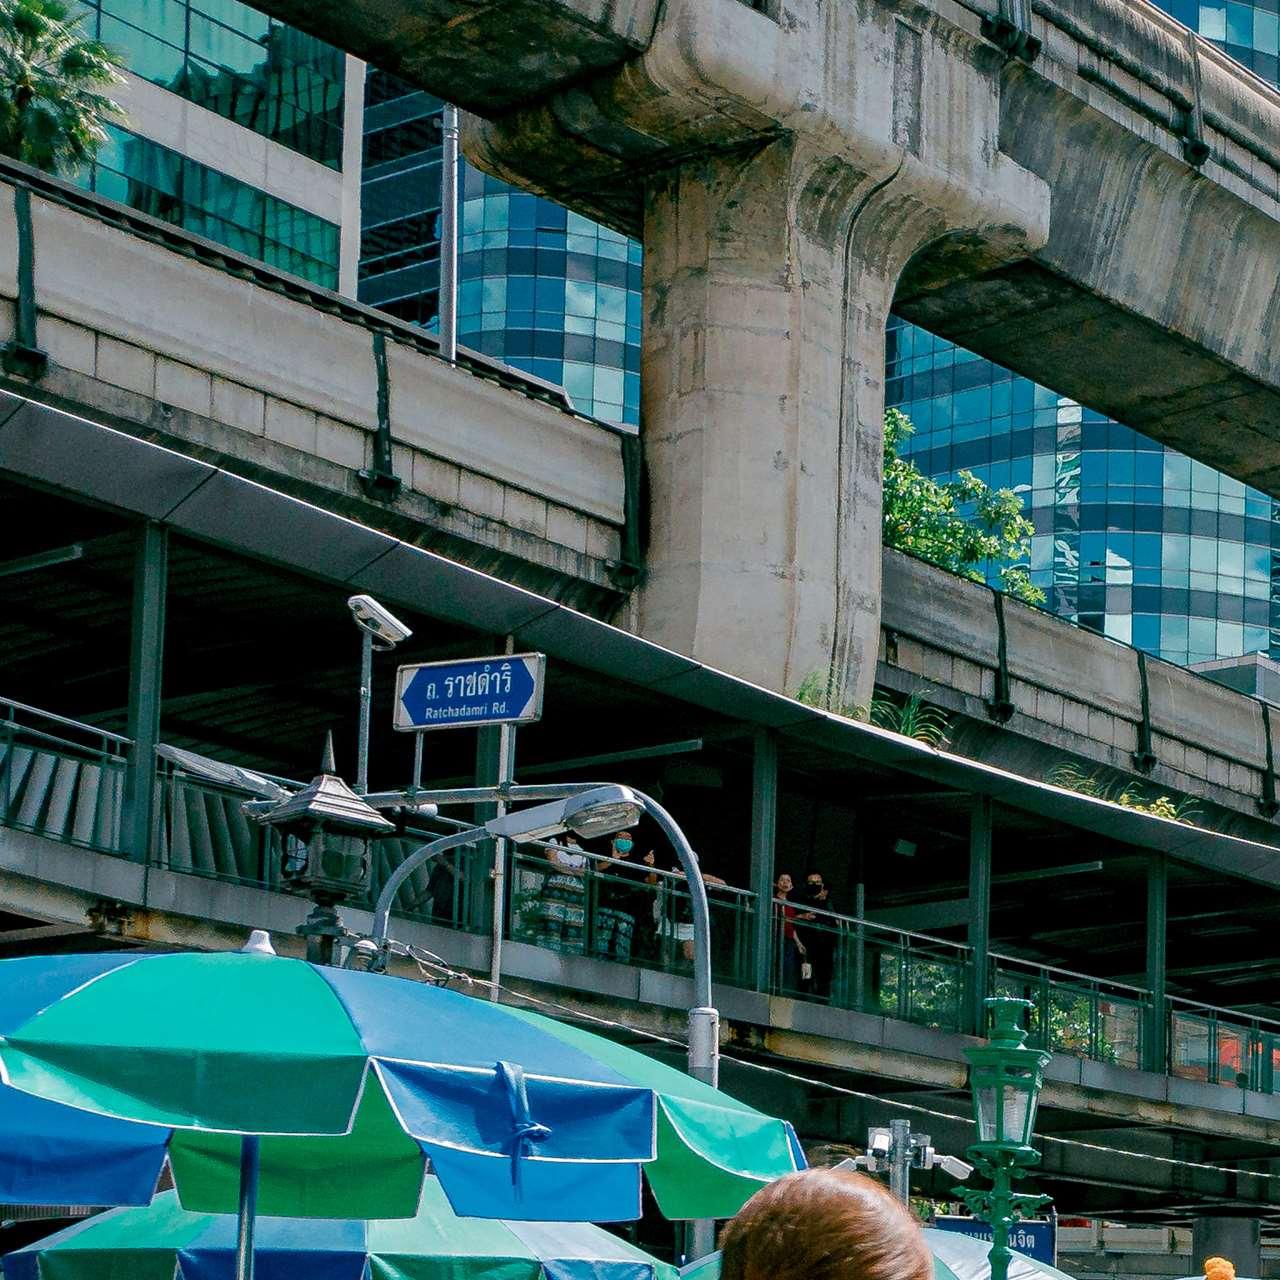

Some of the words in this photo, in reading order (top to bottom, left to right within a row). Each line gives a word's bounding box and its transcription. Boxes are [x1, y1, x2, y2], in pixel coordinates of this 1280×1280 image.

[444, 662, 512, 698] ราชดำริ
[425, 703, 488, 720] Ratchadamri
[492, 702, 510, 715] Rd.
